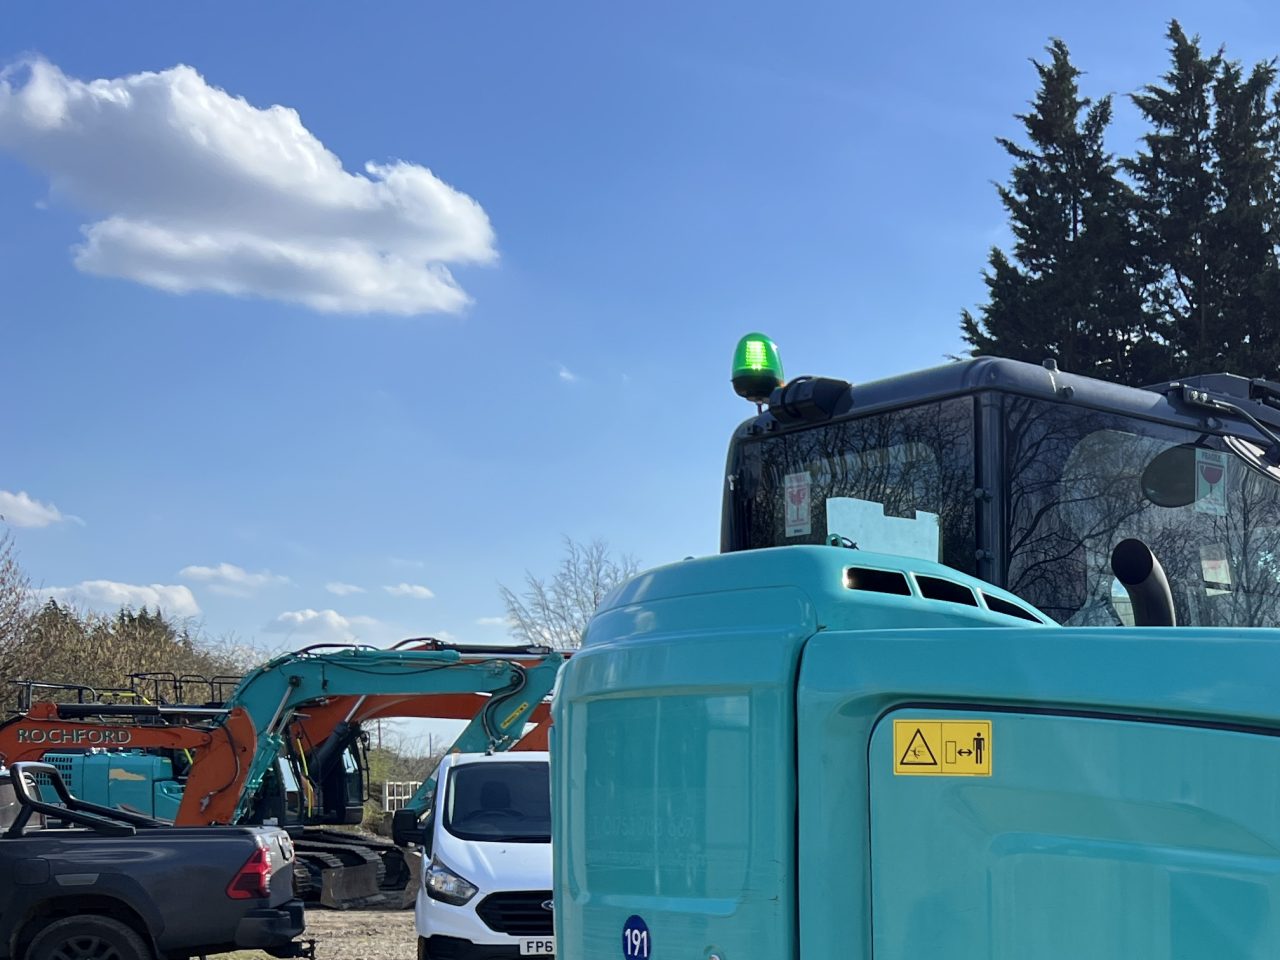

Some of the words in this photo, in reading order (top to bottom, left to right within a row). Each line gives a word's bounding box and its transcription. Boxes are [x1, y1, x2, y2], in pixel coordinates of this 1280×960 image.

[18, 729, 132, 744] ROCHFORD
[526, 940, 554, 953] FP6
[625, 928, 648, 958] 191
